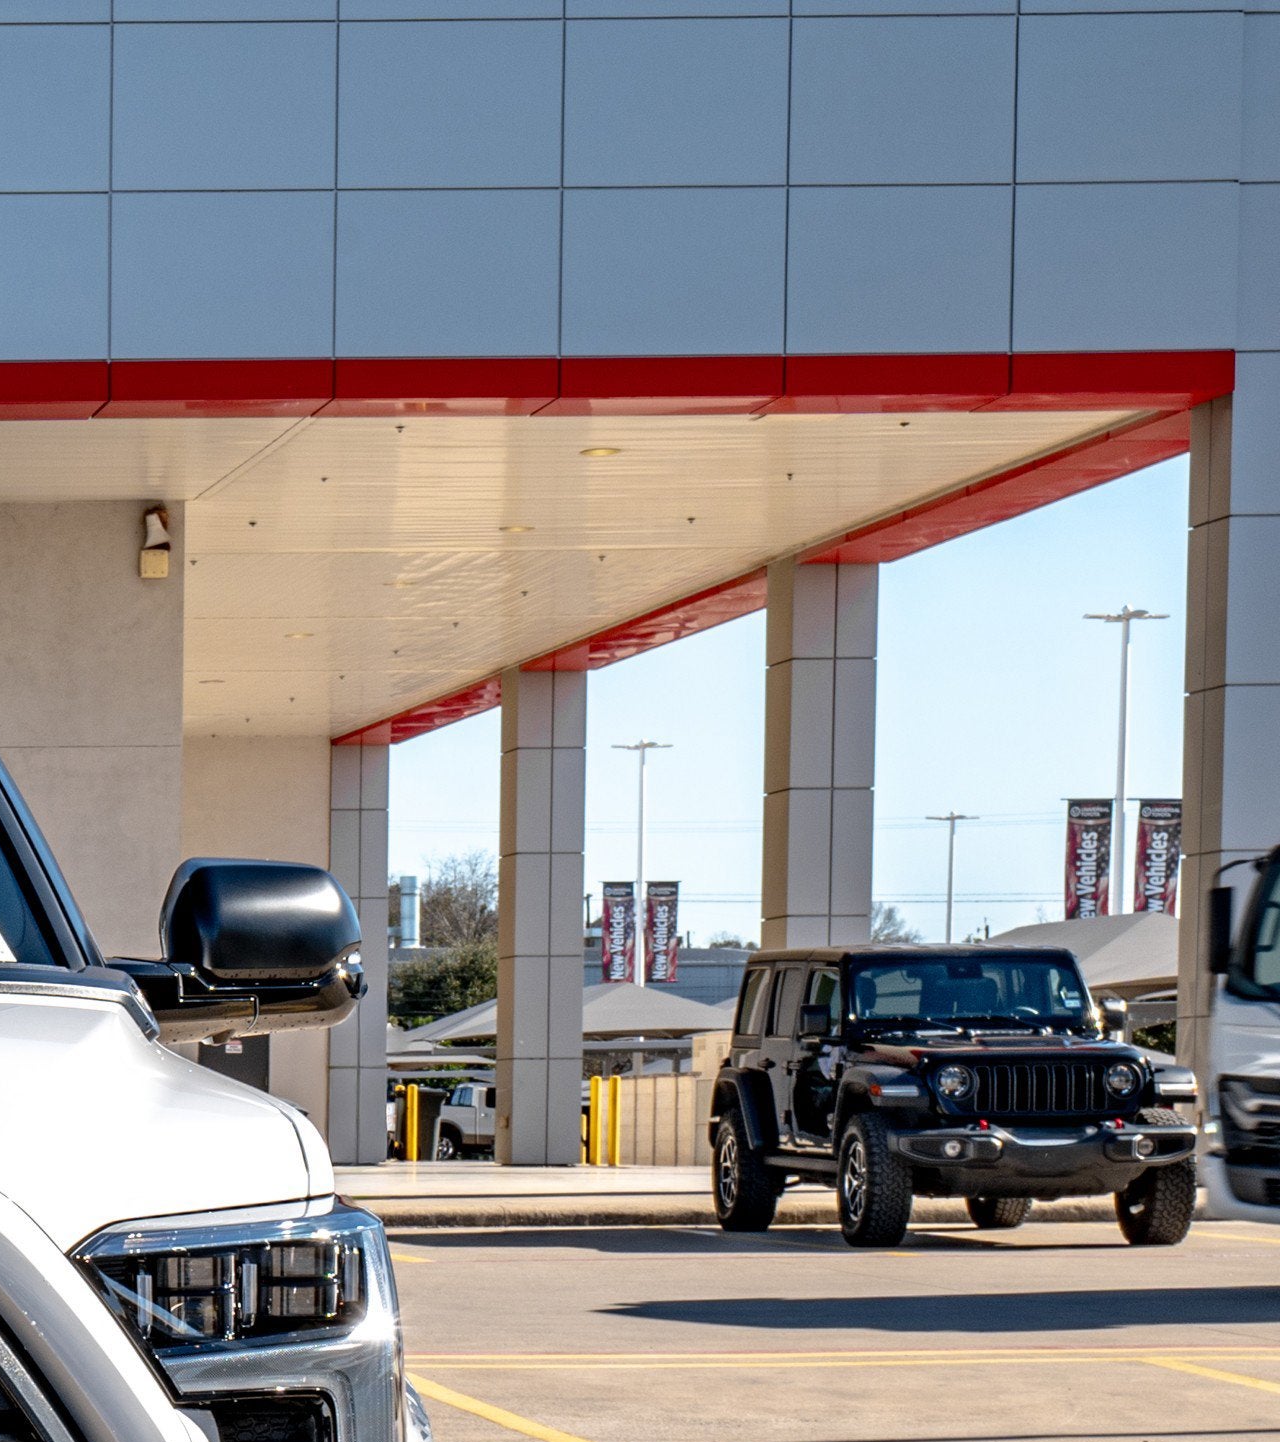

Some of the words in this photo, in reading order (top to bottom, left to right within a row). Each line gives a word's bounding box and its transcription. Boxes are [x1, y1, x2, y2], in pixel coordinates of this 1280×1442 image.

[1077, 831, 1098, 895] Vehicles
[1146, 831, 1168, 895] Vehicles
[609, 905, 625, 953] Vehicles
[653, 905, 669, 954] Vehicles
[1079, 896, 1096, 919] ew
[610, 953, 625, 979] New
[652, 953, 668, 979] New
